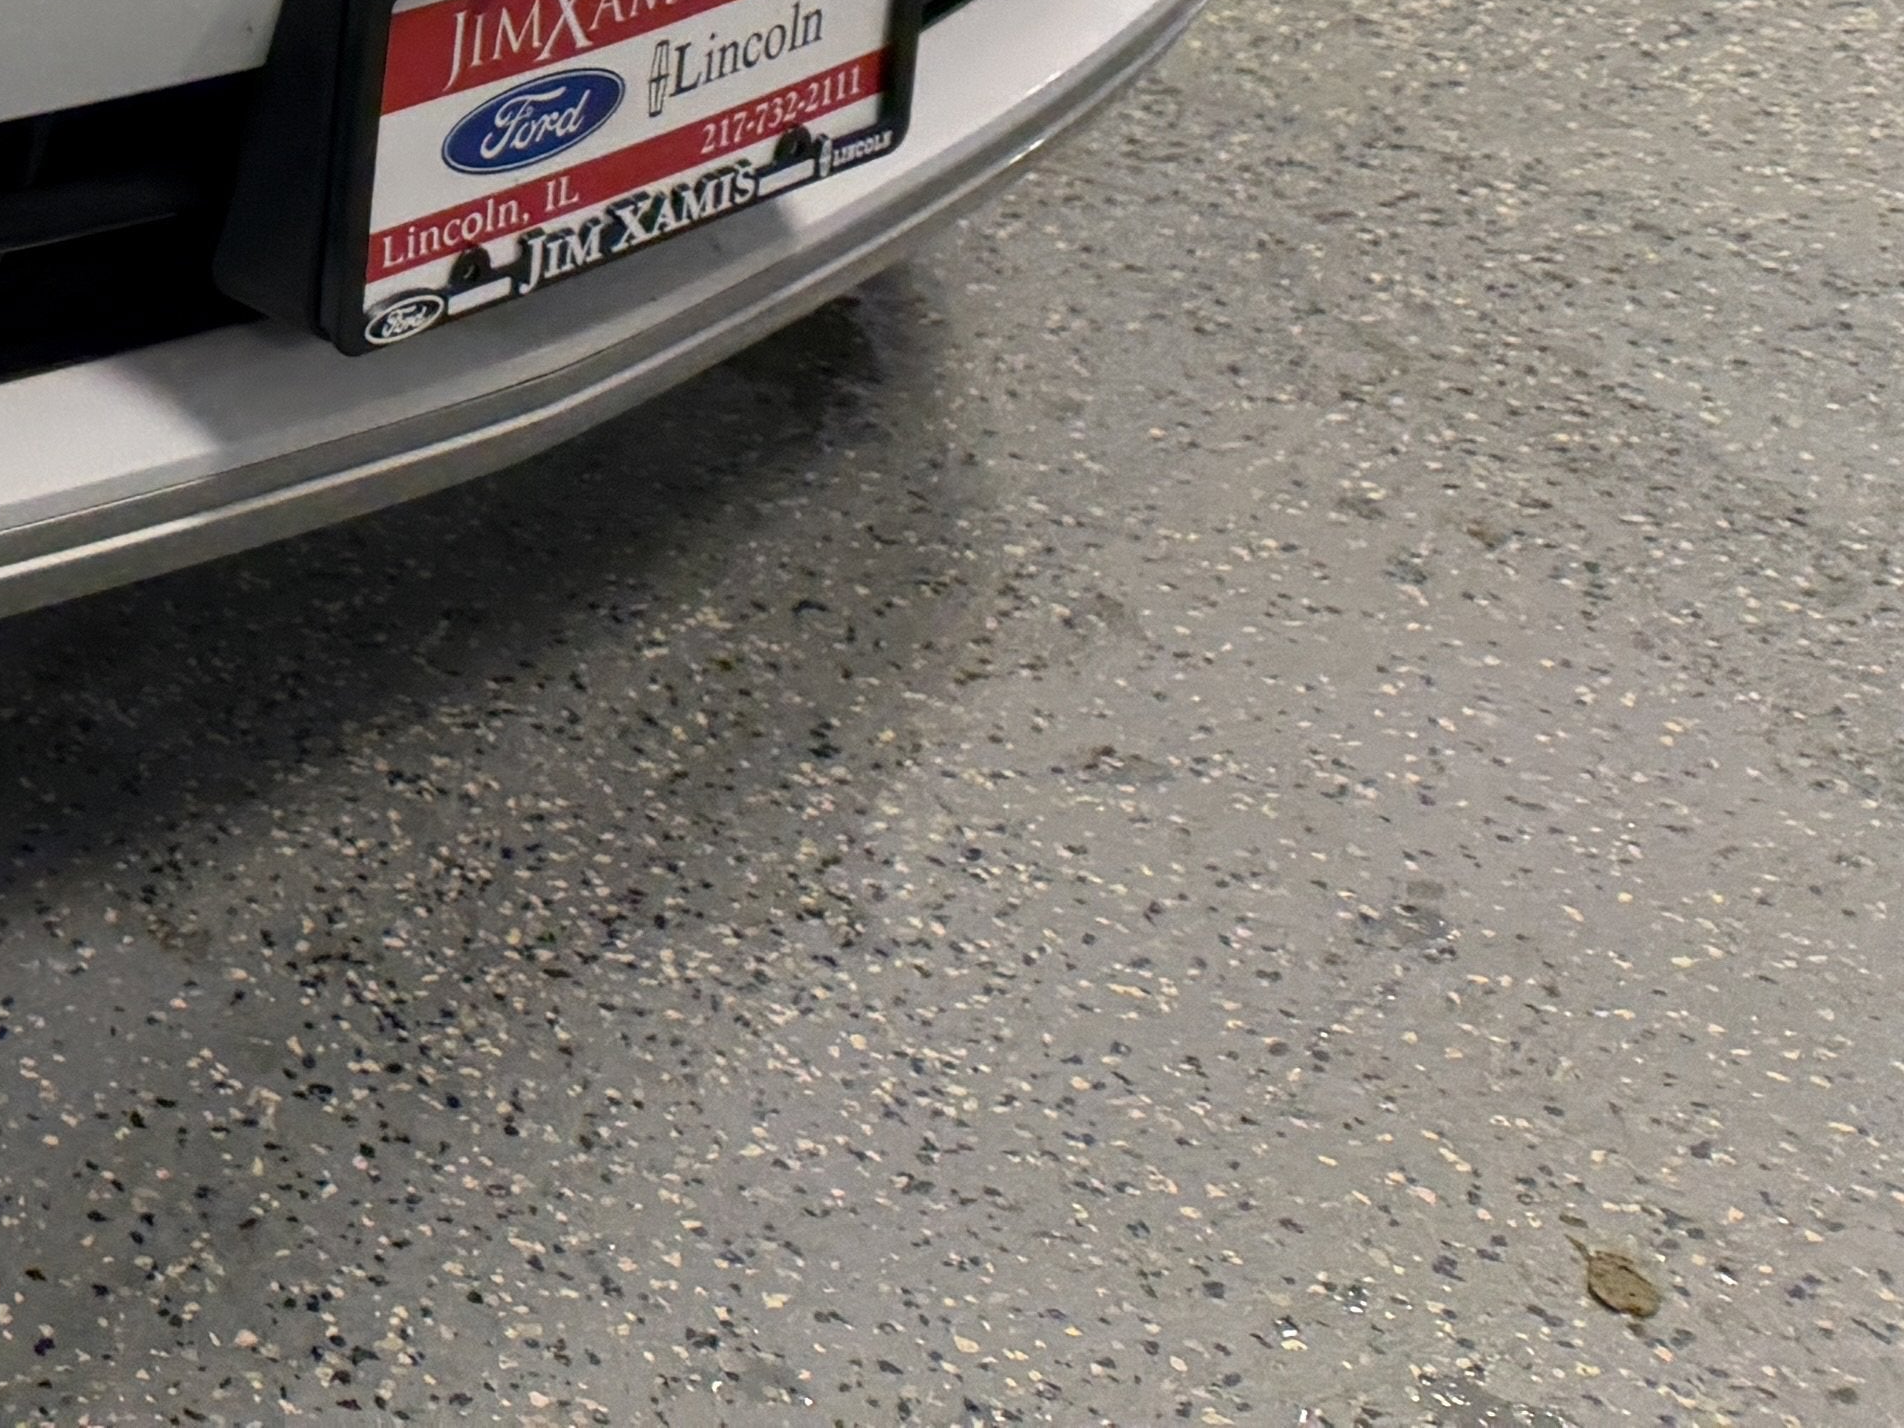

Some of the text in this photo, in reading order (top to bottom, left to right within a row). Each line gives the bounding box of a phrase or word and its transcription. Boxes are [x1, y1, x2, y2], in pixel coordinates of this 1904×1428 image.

[669, 0, 823, 98] Lincoln
[480, 86, 591, 159] Ford
[701, 65, 861, 154] 217-732-2111
[383, 176, 579, 268] Lincoln, IL
[519, 162, 758, 295] JIM XAMIS
